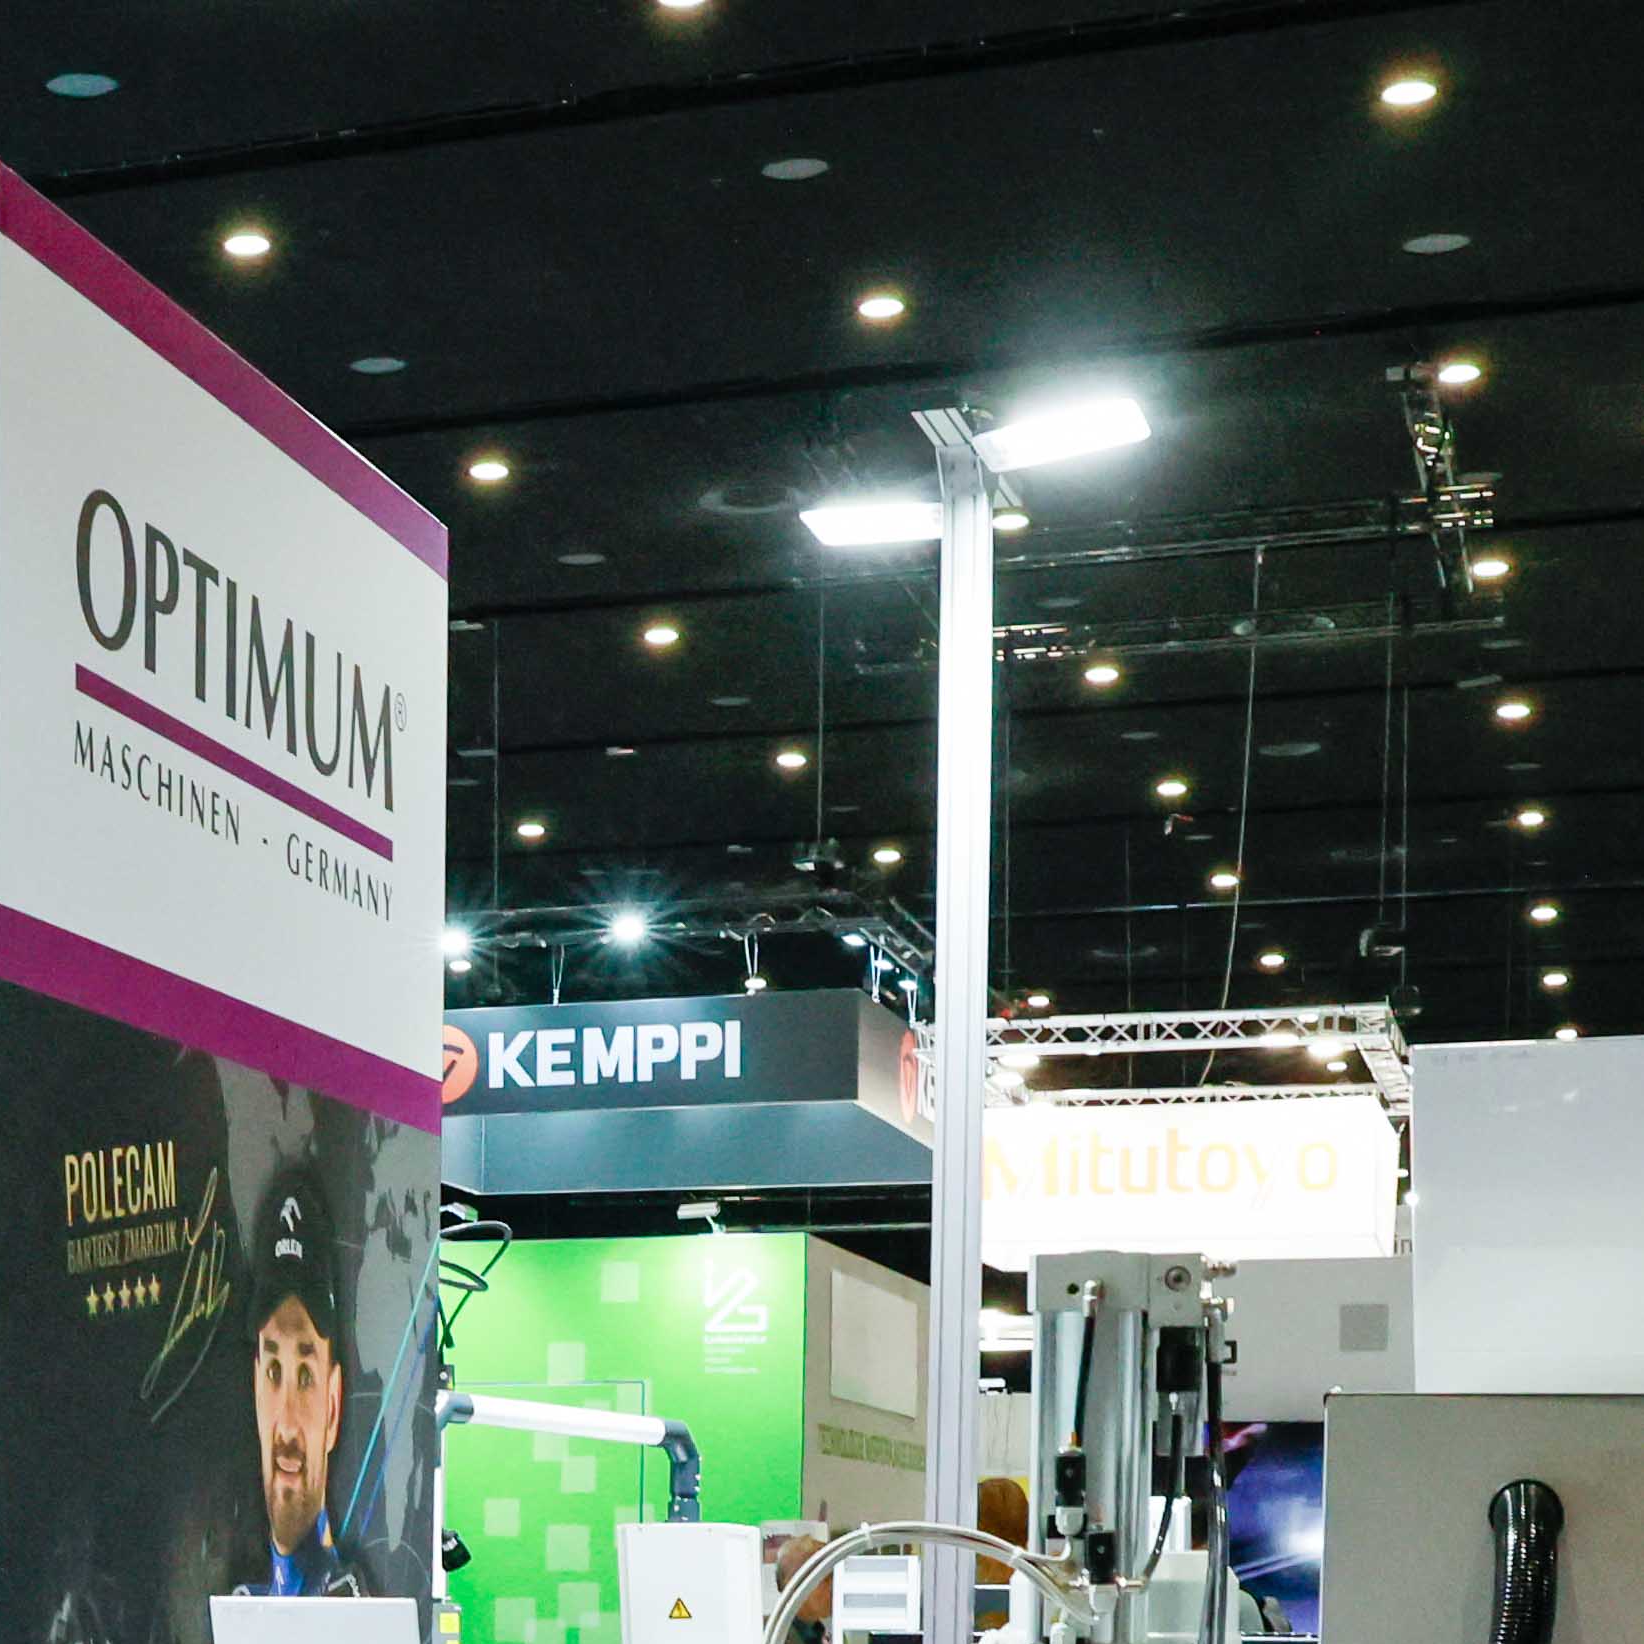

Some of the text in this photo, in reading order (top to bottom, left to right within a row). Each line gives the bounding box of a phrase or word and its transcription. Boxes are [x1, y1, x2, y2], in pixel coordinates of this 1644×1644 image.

[76, 488, 393, 813] OPTIMUM
[74, 719, 240, 846] MASCHINEN
[286, 832, 394, 922] GERMANY
[488, 1019, 741, 1089] KEMPPI
[64, 1140, 177, 1227] POLECAM
[981, 1127, 1338, 1210] Mitutoyo
